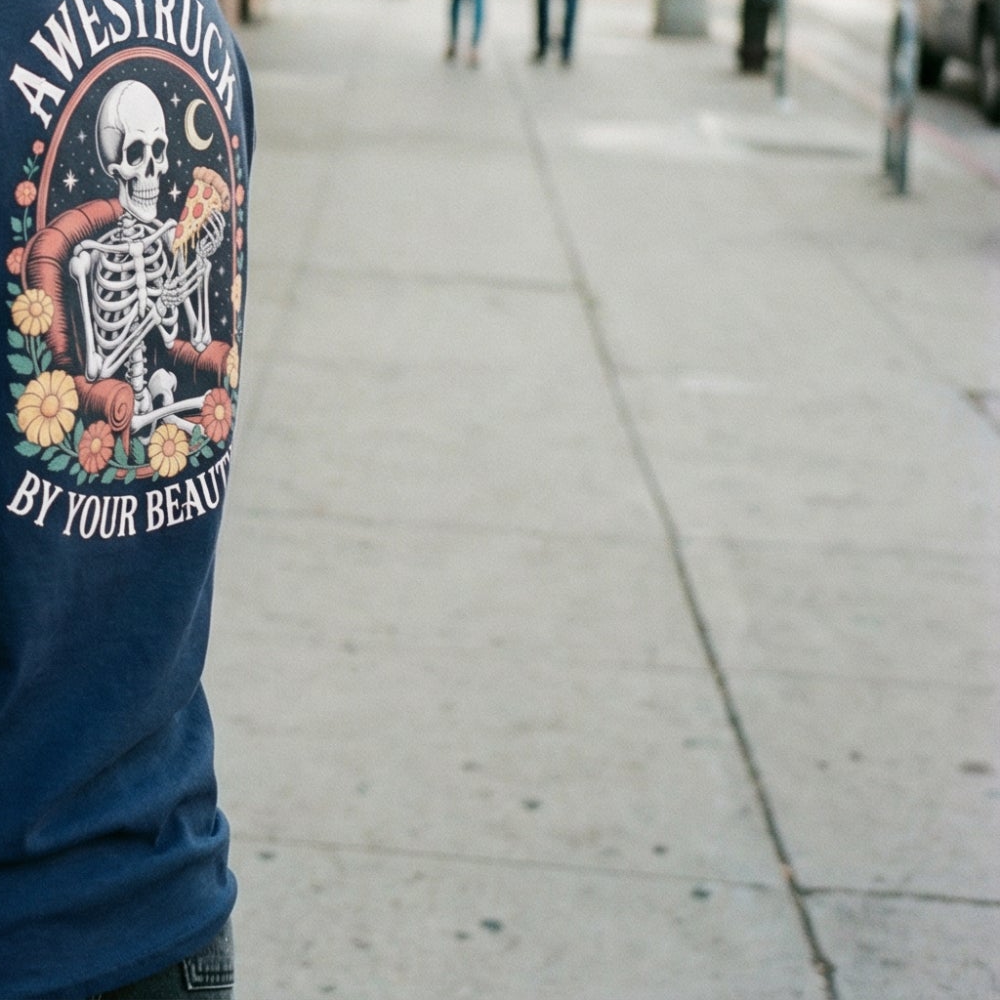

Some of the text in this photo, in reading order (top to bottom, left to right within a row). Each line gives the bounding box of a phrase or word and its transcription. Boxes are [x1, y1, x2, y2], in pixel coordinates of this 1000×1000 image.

[6, 444, 233, 539] BY YOUR BEAUT
